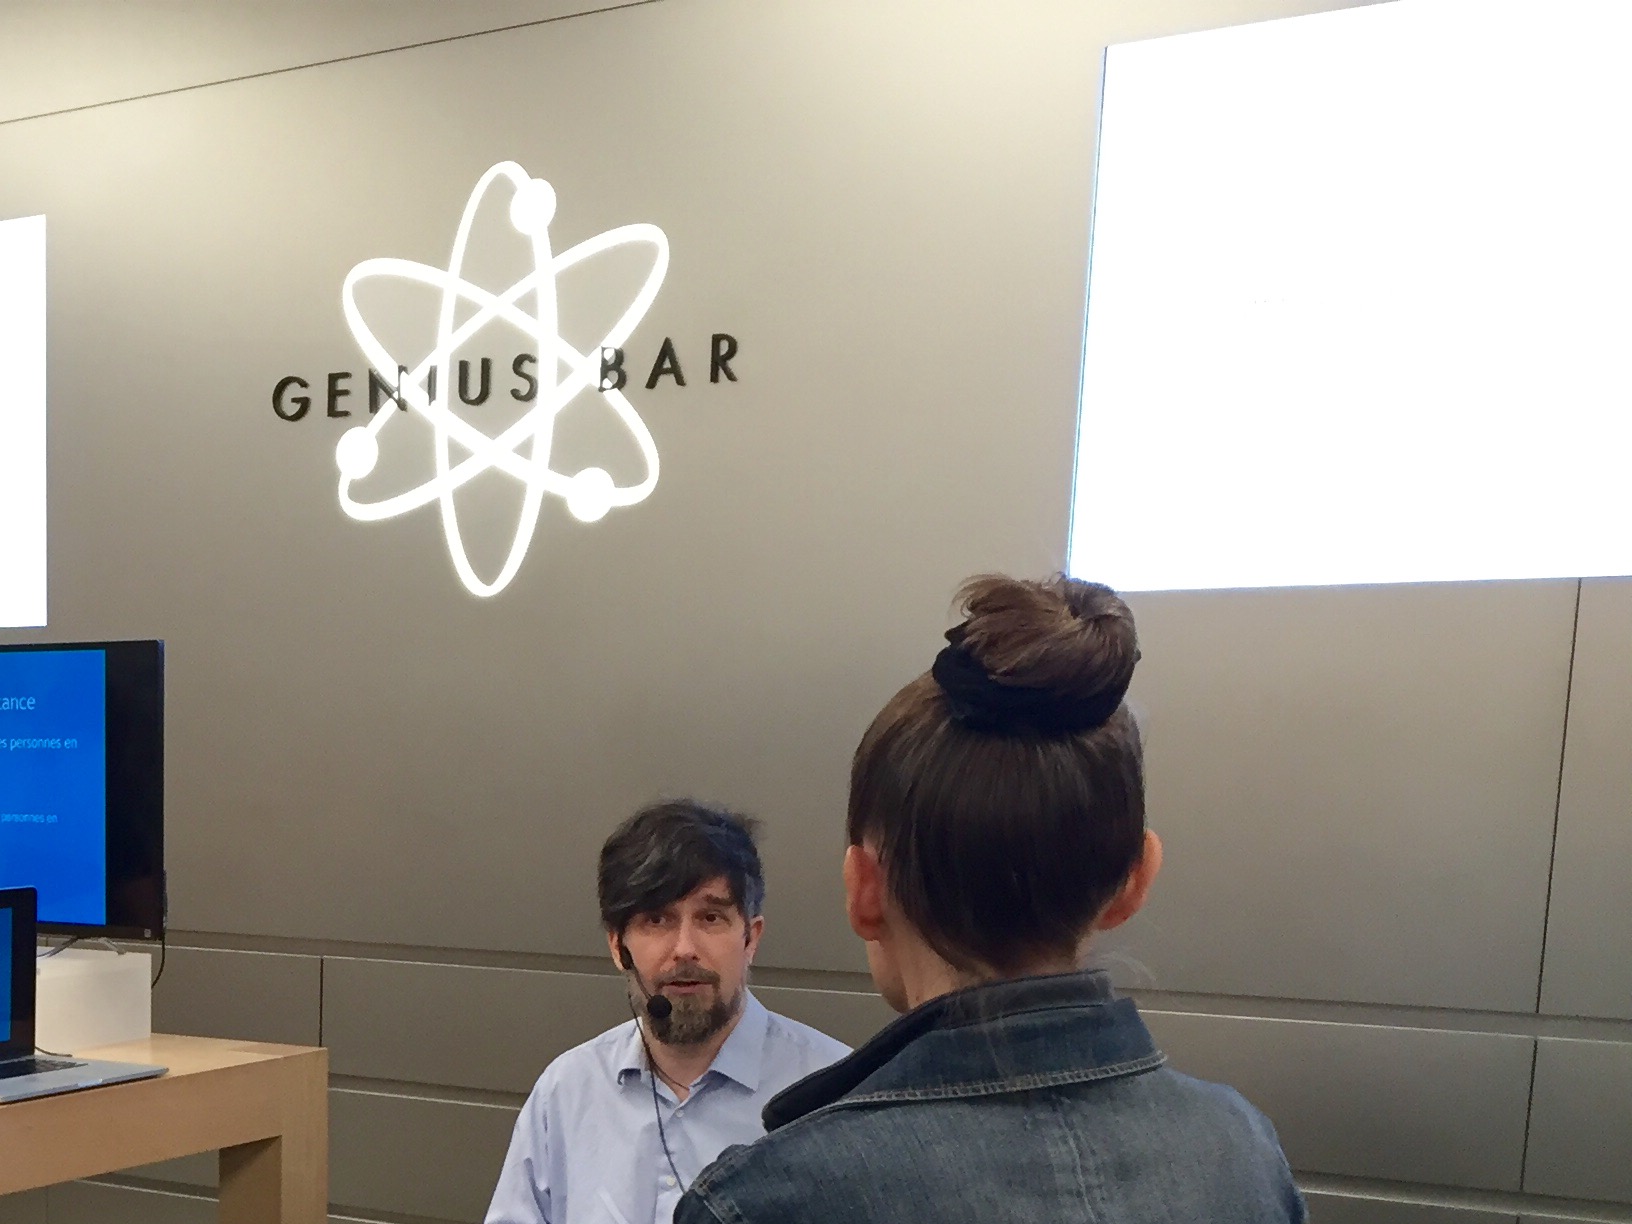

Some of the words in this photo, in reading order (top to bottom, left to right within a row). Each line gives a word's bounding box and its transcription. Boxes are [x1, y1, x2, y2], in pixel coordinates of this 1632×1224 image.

[272, 353, 539, 423] GENIUS
[601, 333, 740, 393] BAR
[10, 738, 61, 751] personnes
[64, 738, 78, 749] en
